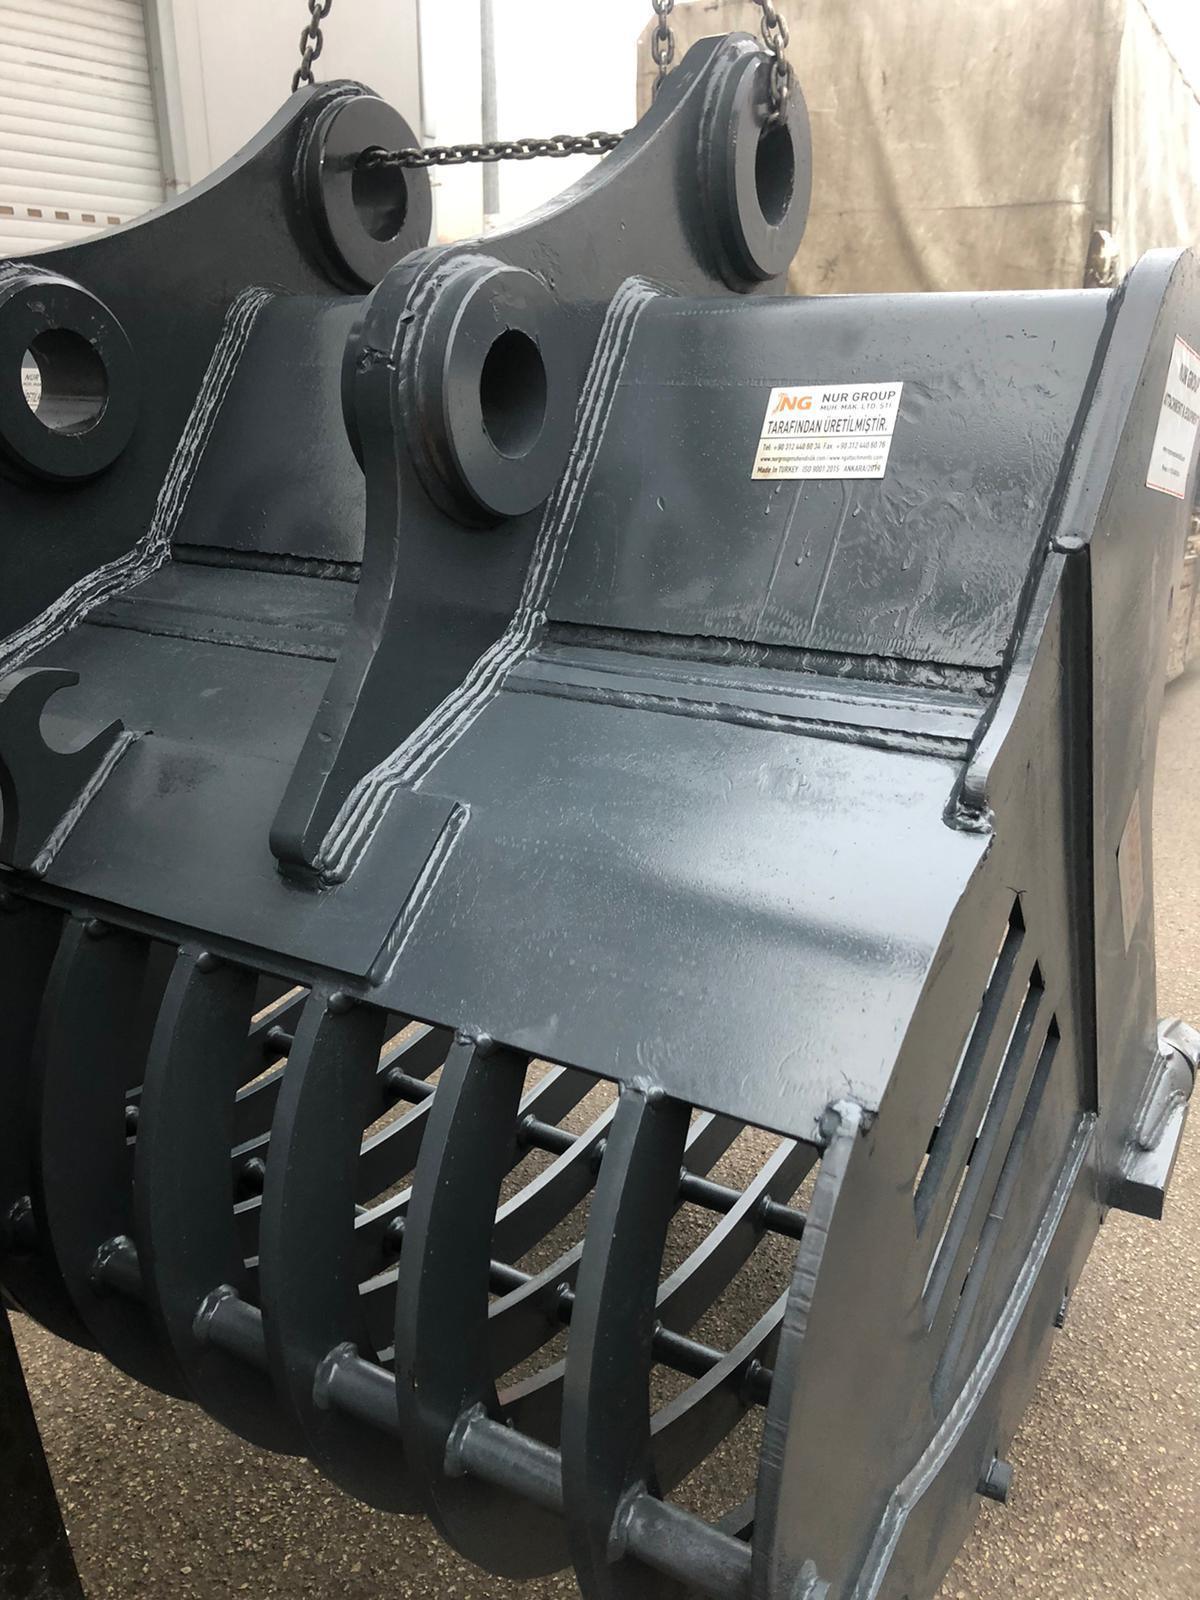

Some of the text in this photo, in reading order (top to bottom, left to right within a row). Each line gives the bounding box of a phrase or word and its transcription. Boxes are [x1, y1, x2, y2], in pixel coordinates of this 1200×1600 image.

[822, 390, 896, 403] NUR GROUP
[767, 414, 889, 435] TARAFINDAN ÜRETİLMİŞTİR.
[757, 465, 772, 474] Made
[779, 464, 799, 473] TURKEY
[802, 464, 812, 472] ISO
